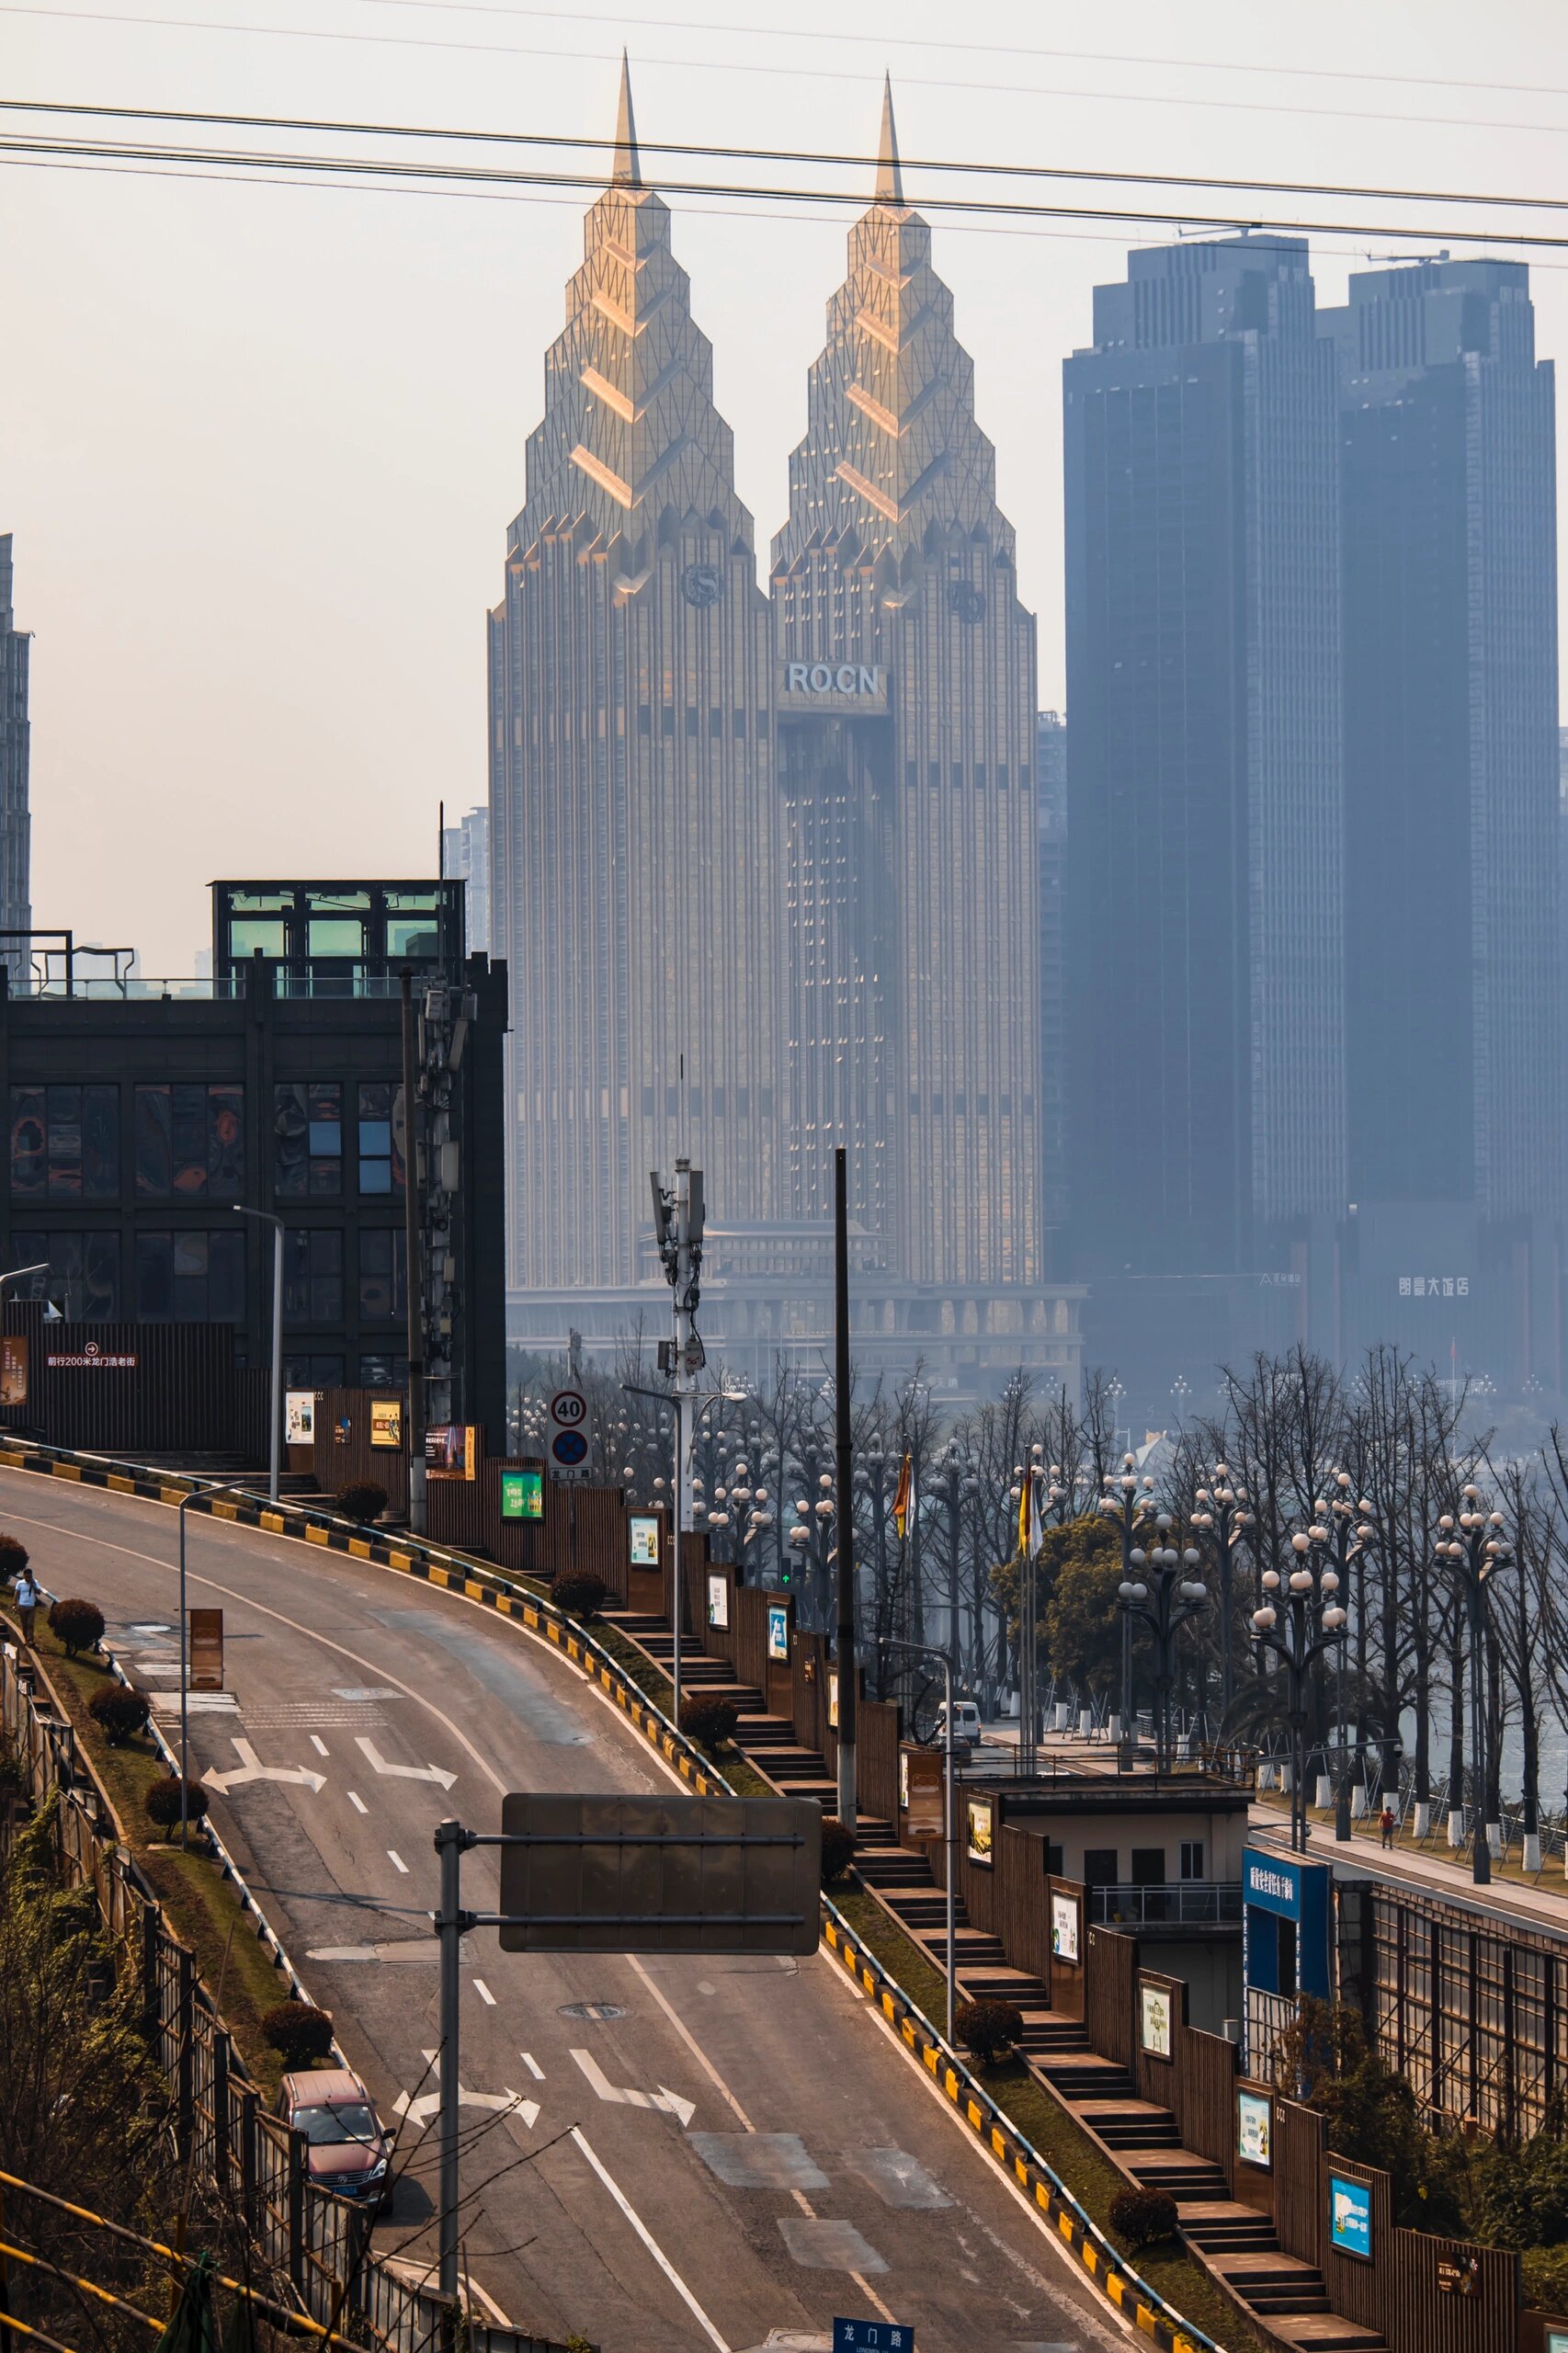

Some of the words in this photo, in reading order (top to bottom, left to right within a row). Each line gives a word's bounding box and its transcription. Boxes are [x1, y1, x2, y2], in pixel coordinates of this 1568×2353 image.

[1399, 1277, 1469, 1297] 朗豪大饭店
[48, 1357, 136, 1367] 前行200米龙门浩老街
[557, 1401, 581, 1417] 40
[551, 1469, 590, 1479] 龙门路
[1250, 1866, 1293, 1902] 质量安全责任重于泰山
[844, 2324, 902, 2347] 龙门路
